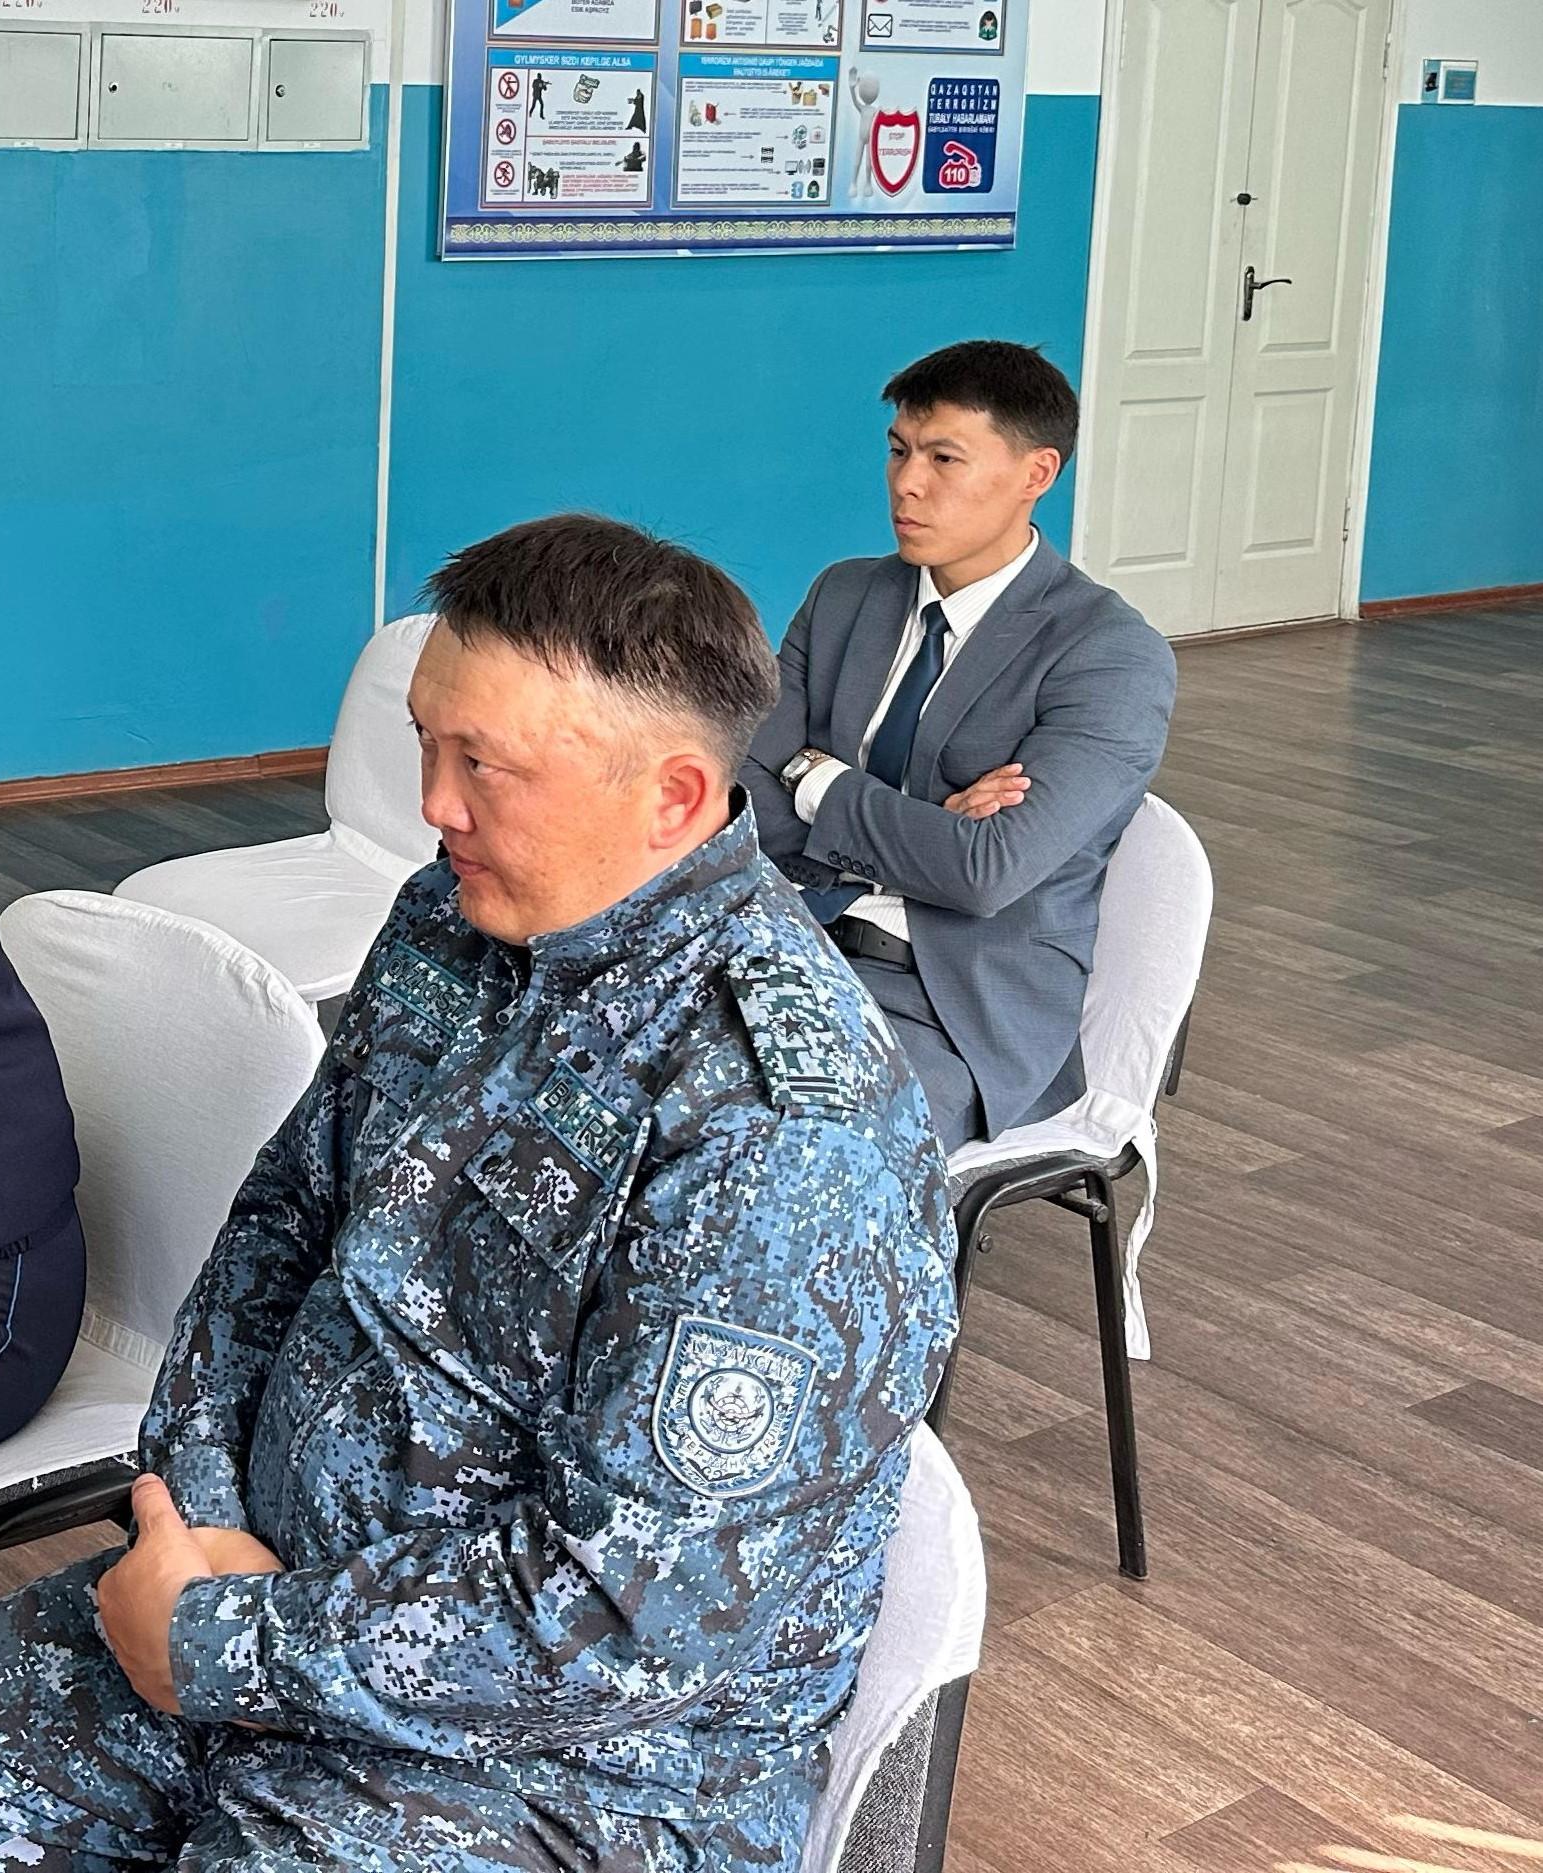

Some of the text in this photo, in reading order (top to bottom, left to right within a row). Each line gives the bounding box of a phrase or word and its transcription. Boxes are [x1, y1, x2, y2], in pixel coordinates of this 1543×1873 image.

[930, 84, 998, 96] QAZAQSTAN
[944, 167, 966, 182] 110
[387, 957, 468, 1021] QAZAQST
